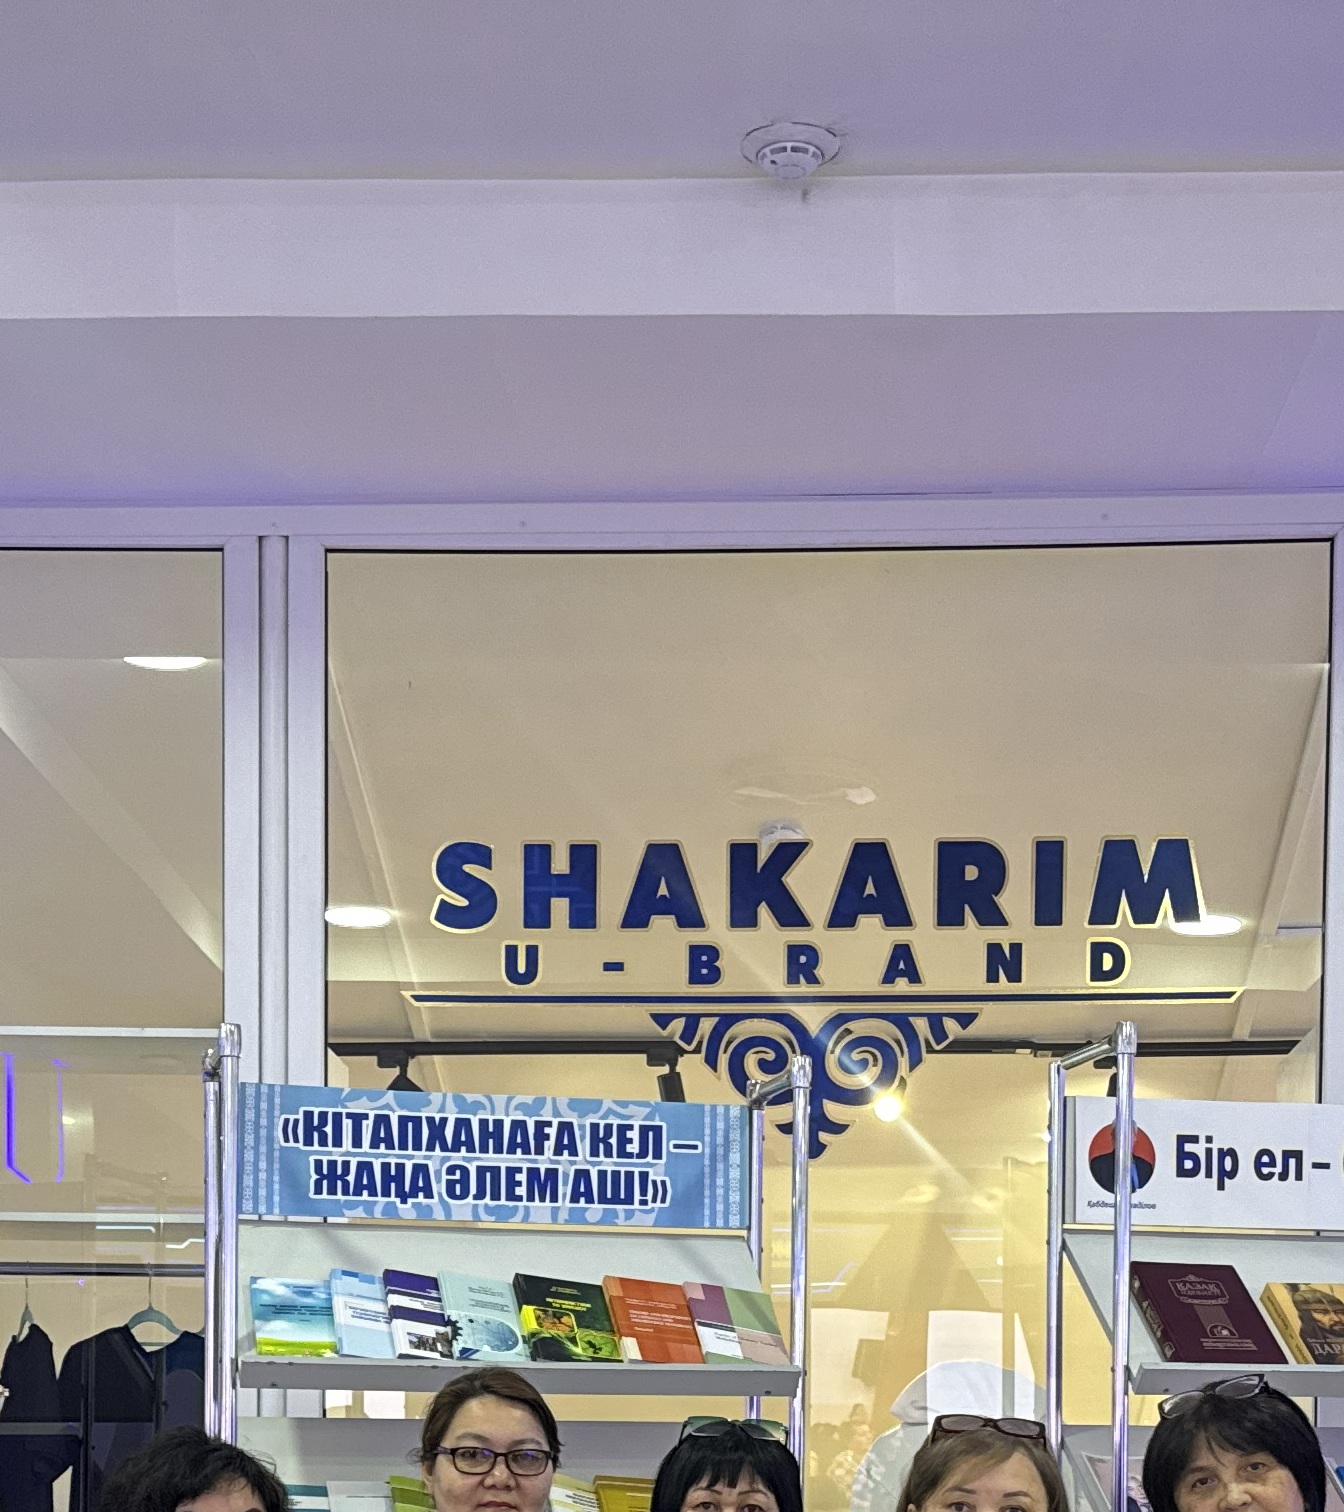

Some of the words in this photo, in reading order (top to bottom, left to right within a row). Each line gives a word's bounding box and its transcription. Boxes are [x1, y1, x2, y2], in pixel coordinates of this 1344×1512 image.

[433, 839, 1204, 932] SHAKARIM
[281, 1109, 580, 1158] «КІТАПХАНАҒА
[589, 1121, 663, 1161] КЕЛ
[313, 1158, 434, 1204] ЖАҢА
[446, 1164, 558, 1205] ӘЛЕМ
[569, 1168, 669, 1207] АШ!»
[1176, 1134, 1239, 1191] Бір
